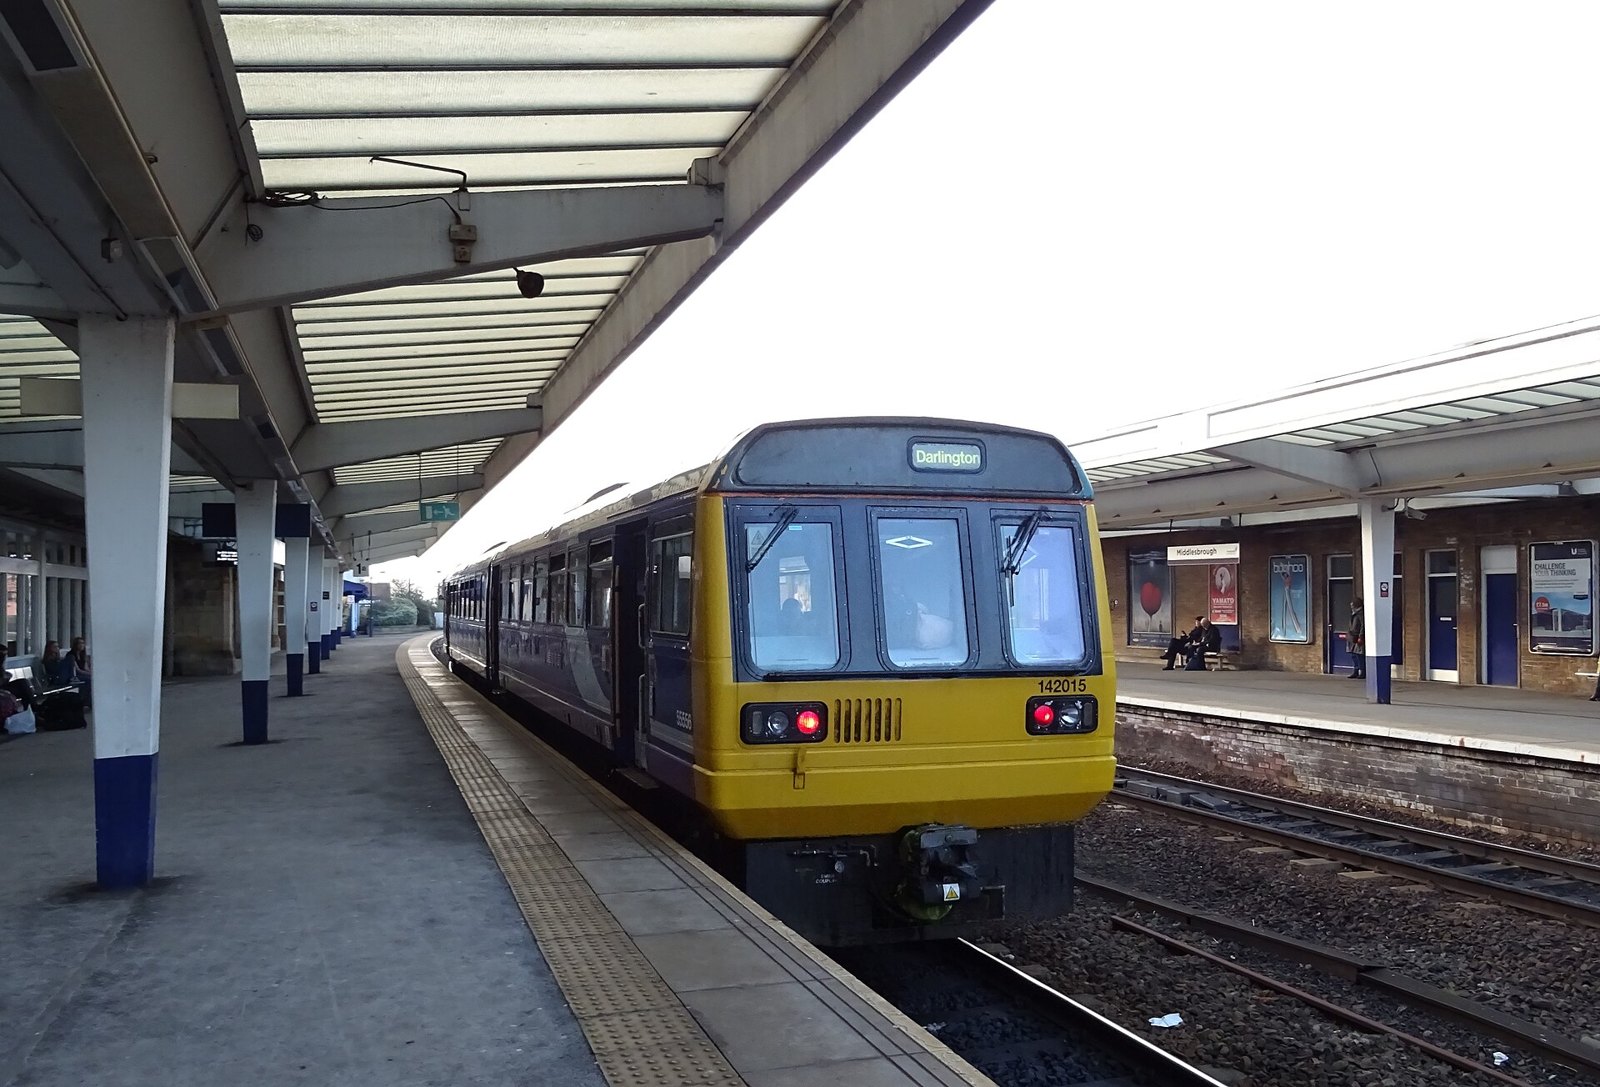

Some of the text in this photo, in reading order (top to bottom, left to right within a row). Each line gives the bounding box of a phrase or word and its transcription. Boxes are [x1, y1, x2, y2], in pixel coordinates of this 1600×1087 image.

[916, 449, 981, 467] Darlington
[1176, 547, 1217, 556] Middlesbrough
[1273, 561, 1304, 573] boohoo
[1534, 562, 1566, 571] CHALLENGE
[1550, 568, 1577, 577] THINKING
[1038, 679, 1087, 693] 142015
